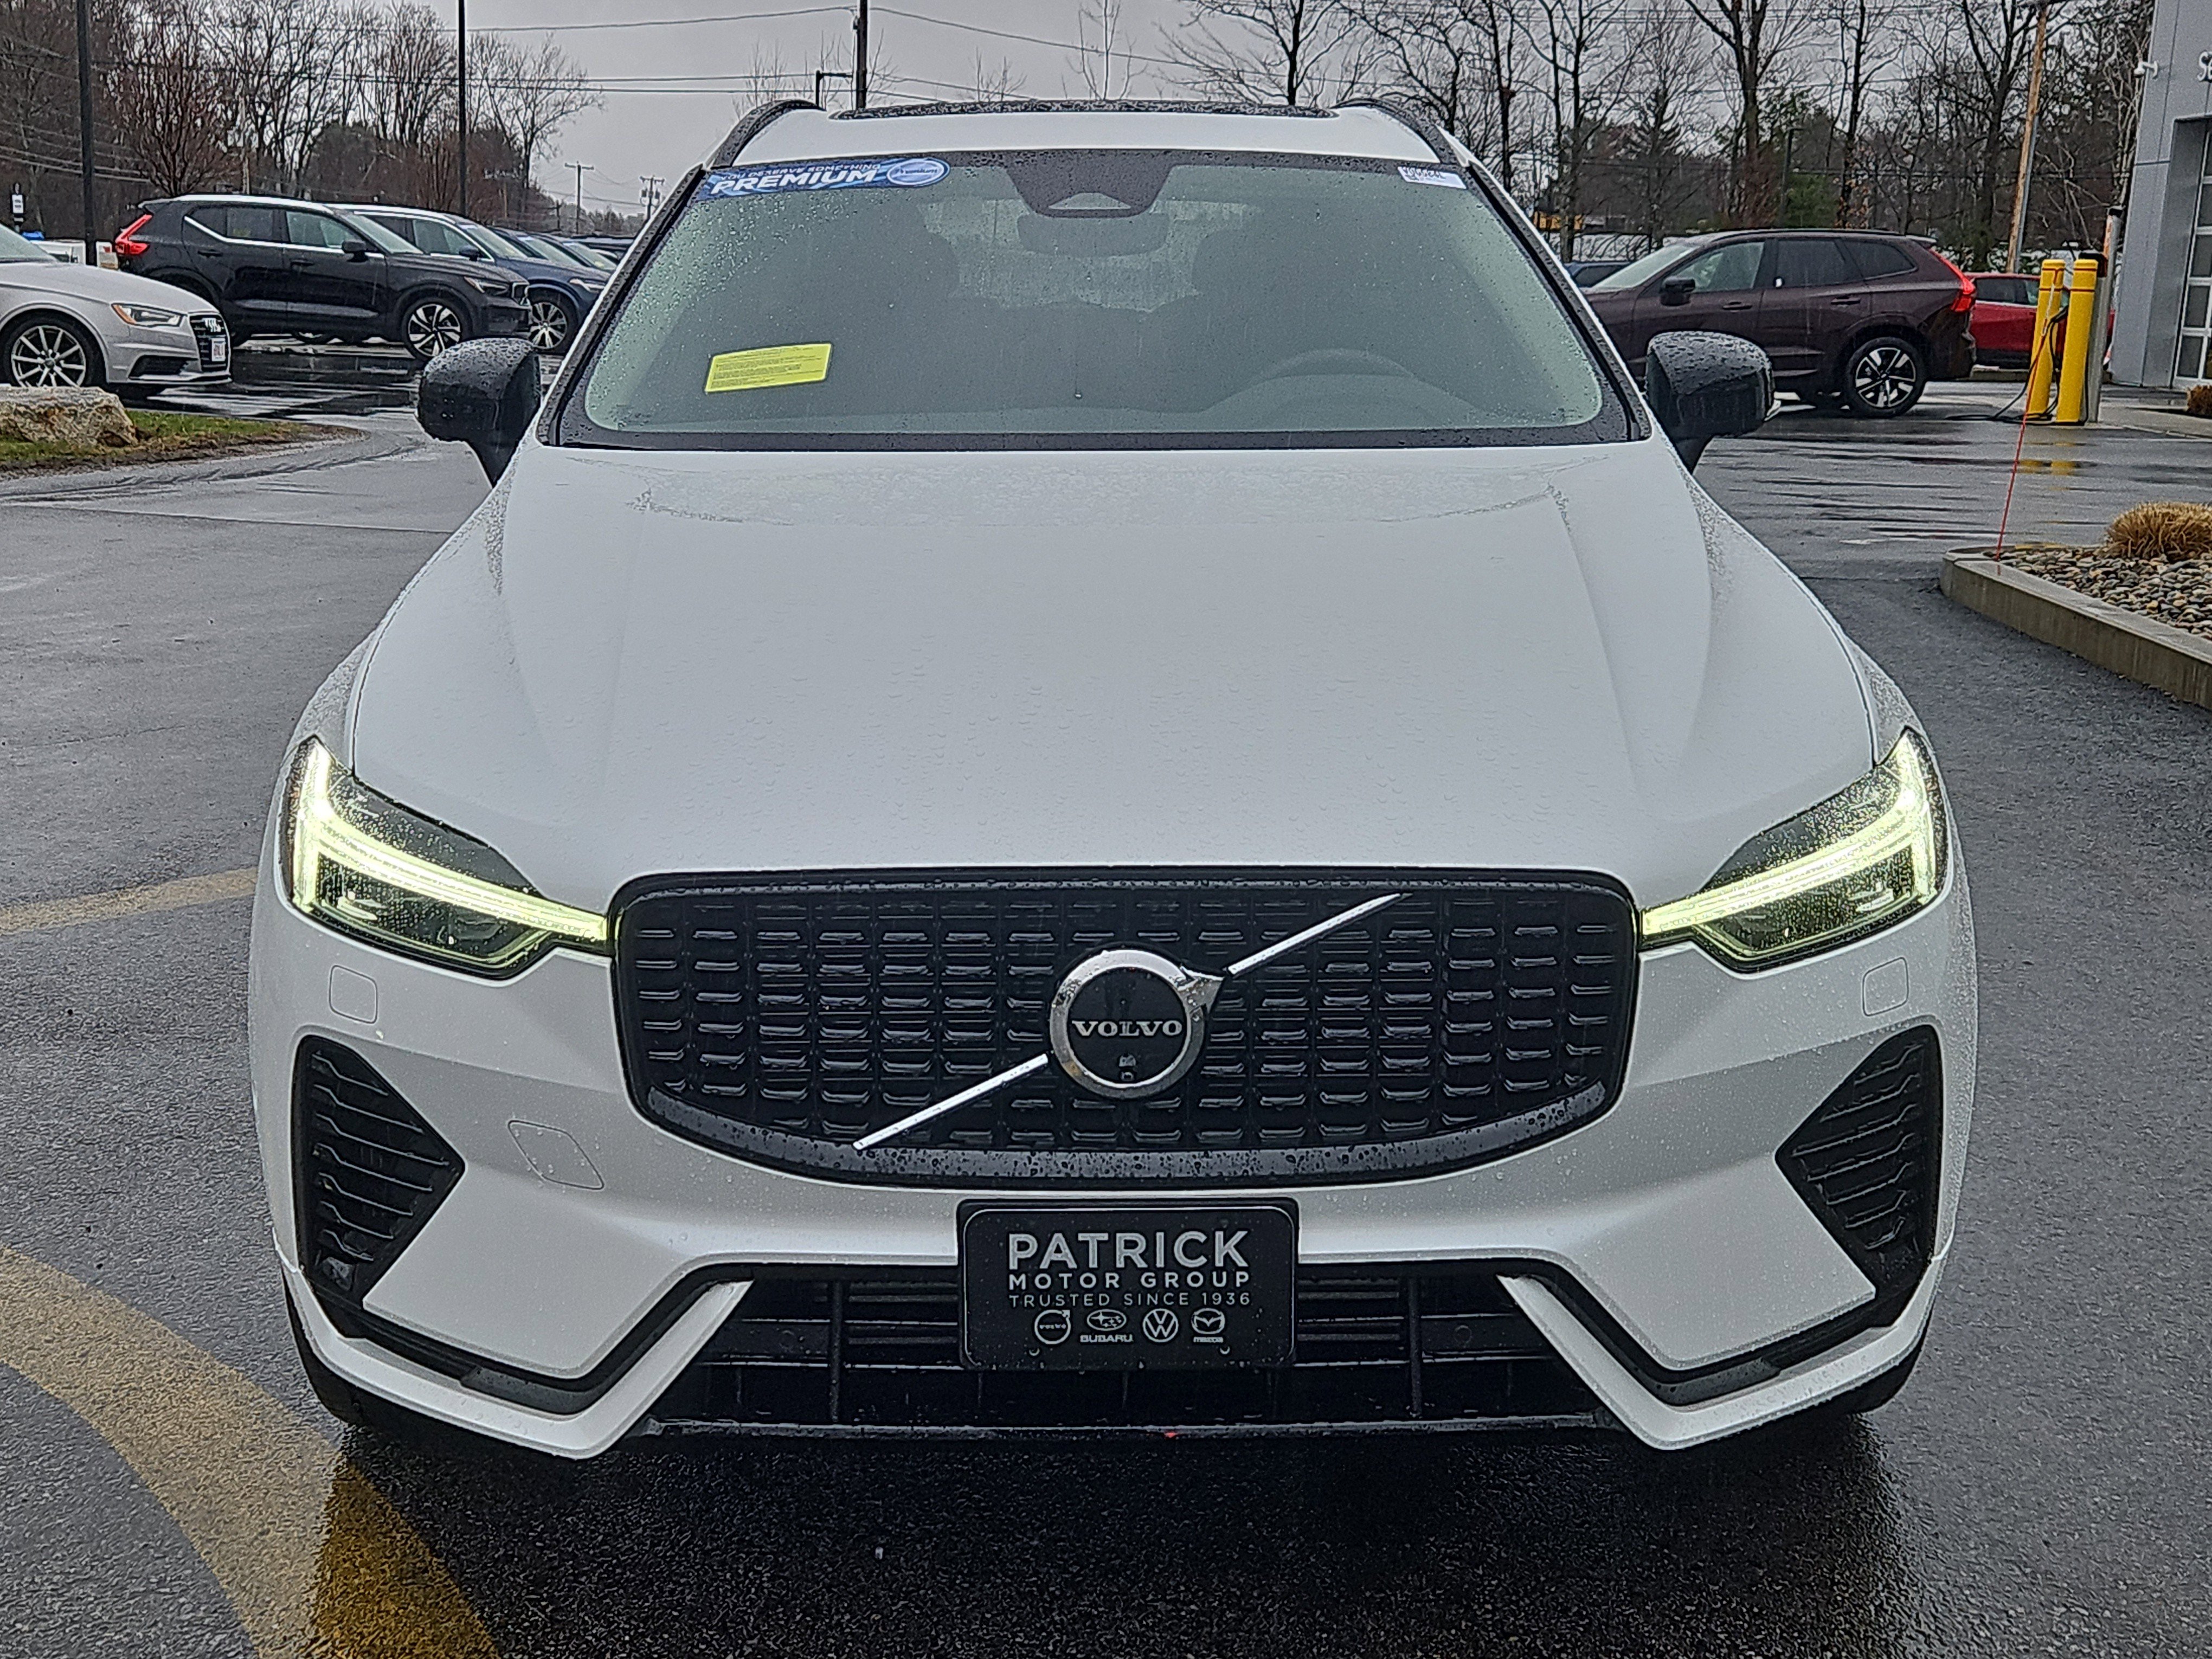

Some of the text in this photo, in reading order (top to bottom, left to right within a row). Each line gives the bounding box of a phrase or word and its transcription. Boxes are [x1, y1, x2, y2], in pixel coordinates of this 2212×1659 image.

[710, 169, 878, 194] PREMIUM
[1071, 1020, 1182, 1037] VOLVO
[1009, 1231, 1249, 1270] PATRICK
[1009, 1271, 1249, 1290] MOTOR GROUP
[1009, 1292, 1250, 1308] TRUSTED SINCE 1936
[1079, 1334, 1134, 1343] SUBARU
